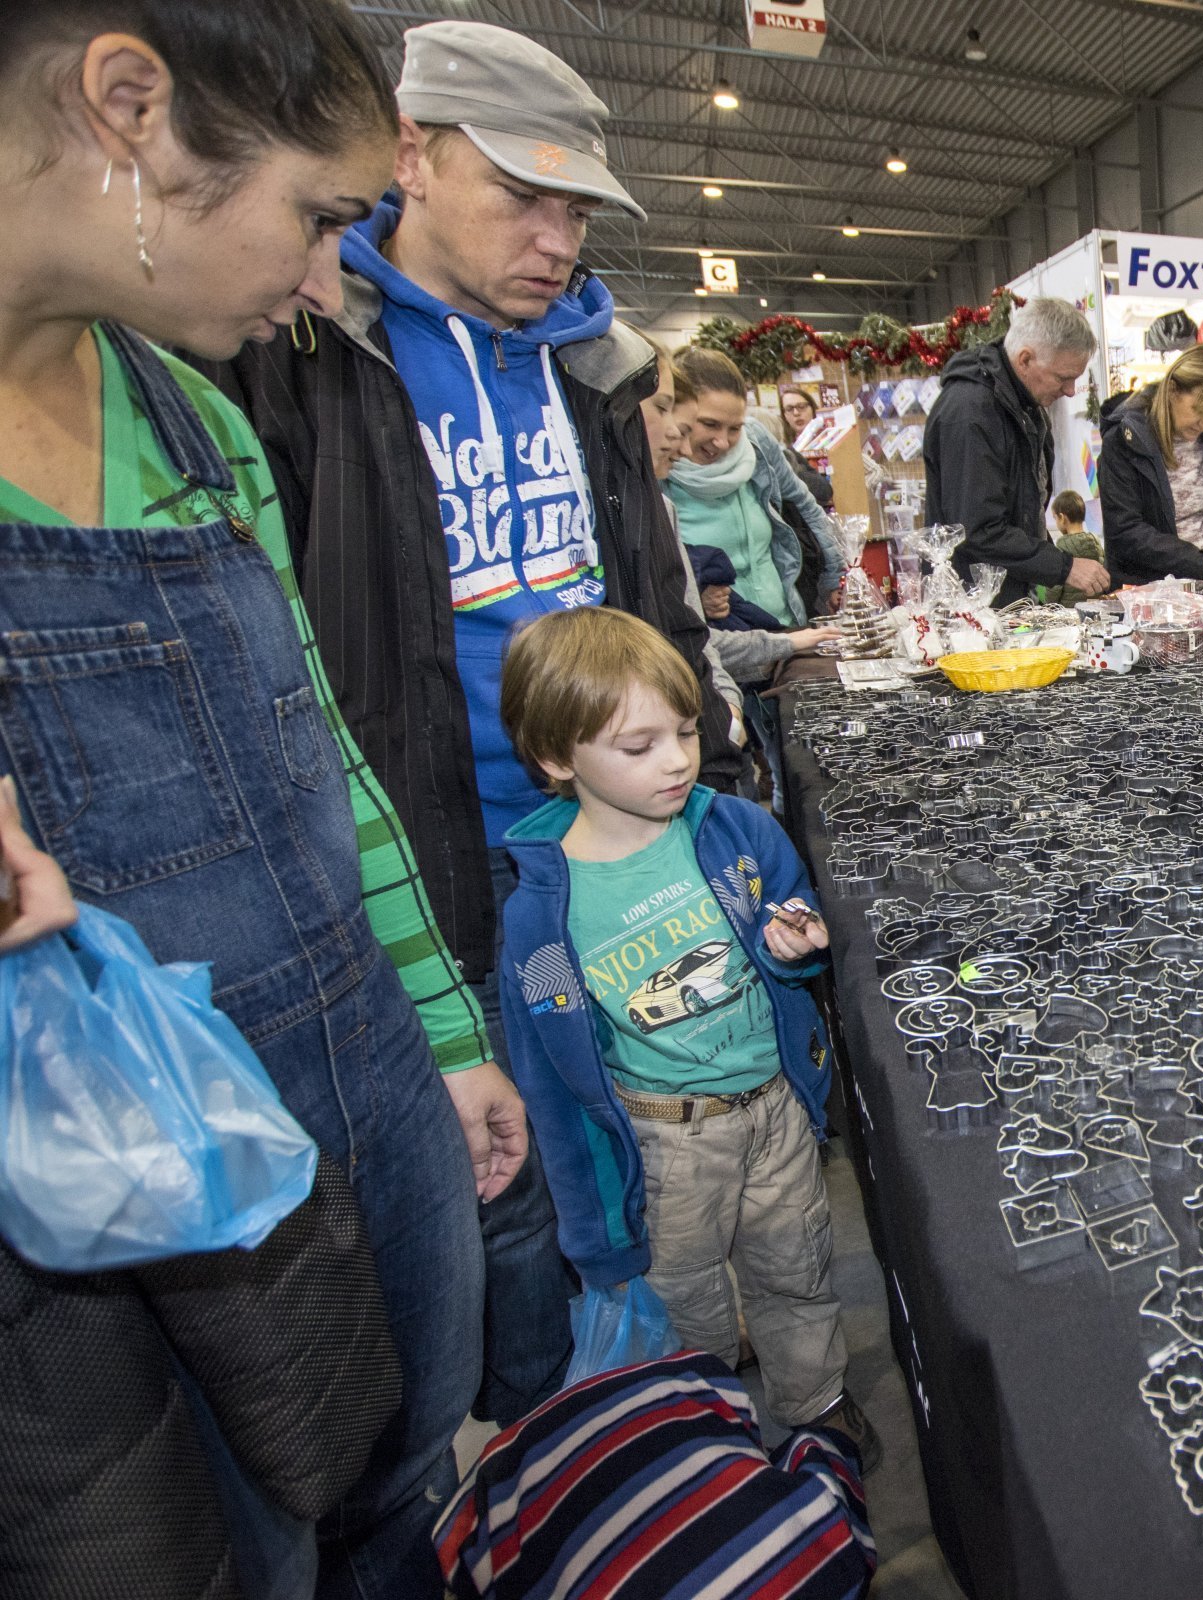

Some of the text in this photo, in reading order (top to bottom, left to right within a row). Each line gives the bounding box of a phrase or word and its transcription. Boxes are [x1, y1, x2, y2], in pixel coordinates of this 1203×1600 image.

[764, 13, 817, 33] HALA 2
[711, 264, 728, 282] C
[621, 878, 693, 926] LOW SPARKS
[662, 896, 722, 946] RAC
